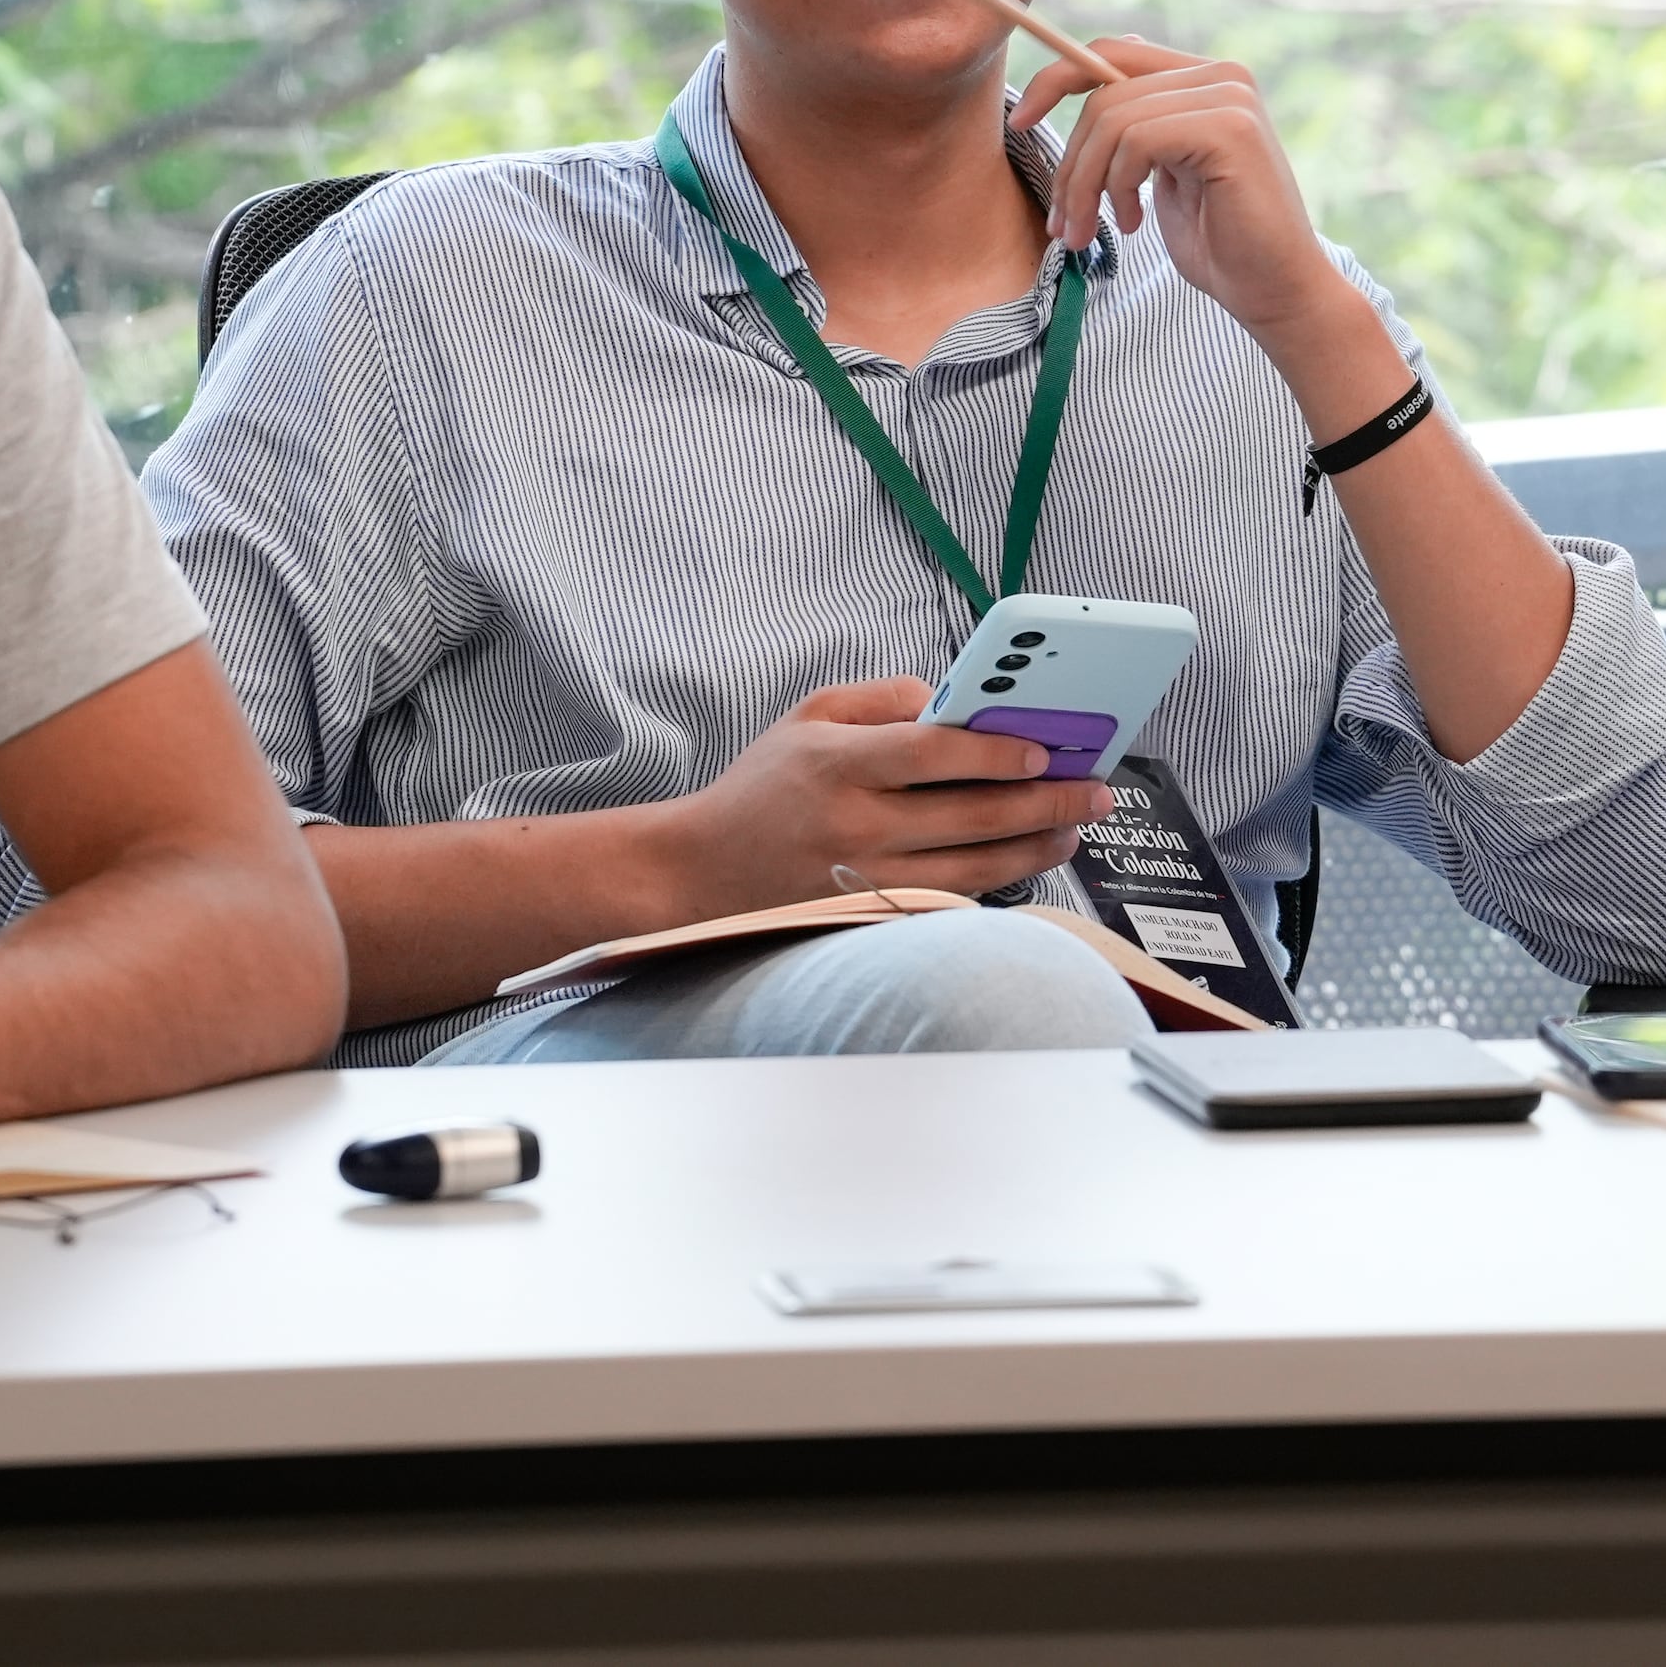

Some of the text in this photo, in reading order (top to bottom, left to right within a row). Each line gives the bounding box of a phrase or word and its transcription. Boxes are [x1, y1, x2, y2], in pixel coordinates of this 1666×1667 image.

[1110, 786, 1151, 809] uro
[1119, 810, 1134, 824] la
[1076, 822, 1189, 851] educación
[1088, 848, 1203, 881] en Colombia
[1166, 887, 1197, 897] Colombia
[1134, 913, 1218, 932] SAMUEL MACHADO
[1146, 940, 1234, 960] UNIVERSIDAD EAFIT
